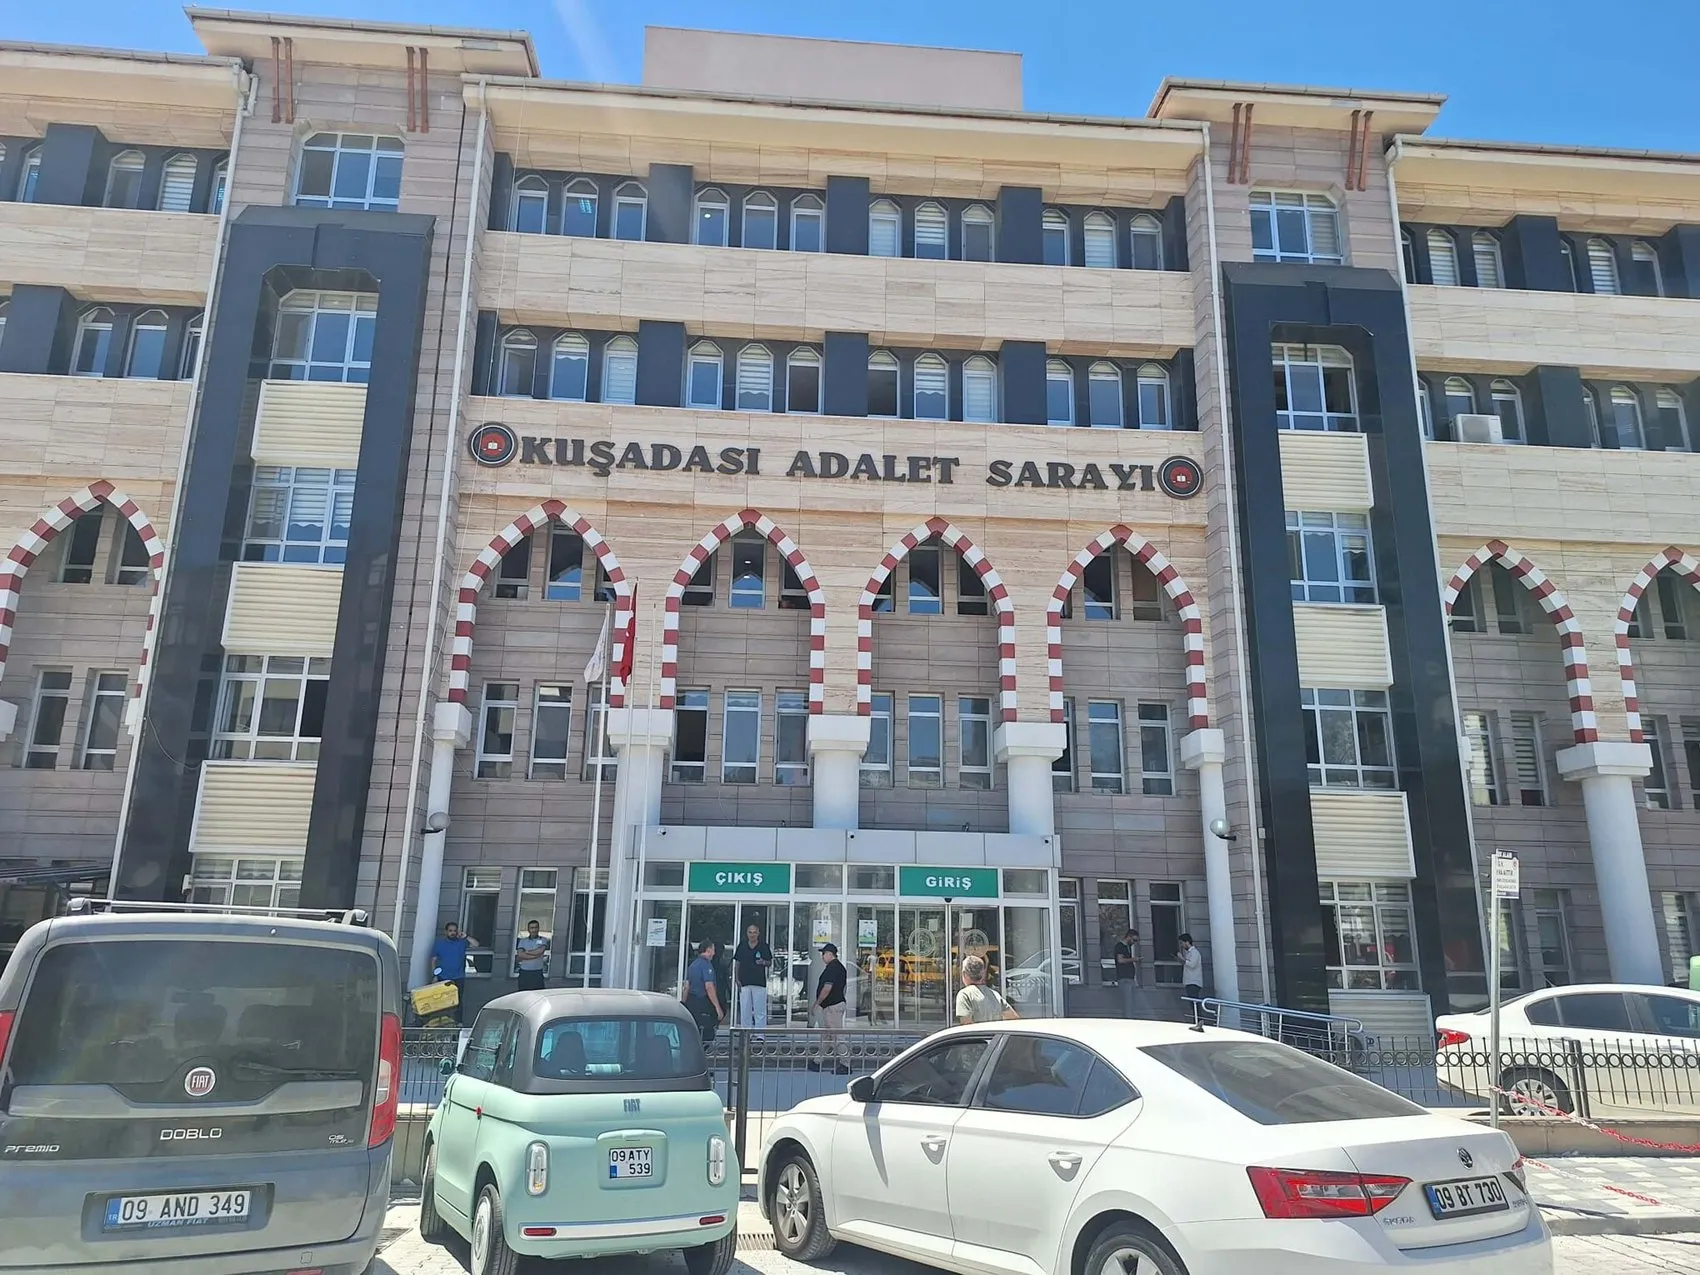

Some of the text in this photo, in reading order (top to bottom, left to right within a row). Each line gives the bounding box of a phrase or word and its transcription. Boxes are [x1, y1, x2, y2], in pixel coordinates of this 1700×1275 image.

[519, 436, 1156, 492] KUŞADASI ADALET SARAYI
[715, 872, 763, 887] ÇIKIŞ
[191, 1075, 210, 1089] FIAT
[623, 1098, 641, 1112] FIAT
[159, 1127, 223, 1141] DOBLO
[611, 1149, 650, 1162] 09 ATY
[629, 1162, 651, 1175] 539
[1434, 1186, 1456, 1210] 09
[1455, 1182, 1475, 1207] BT
[1475, 1180, 1503, 1204] 730
[121, 1193, 246, 1221] 09 AND 349
